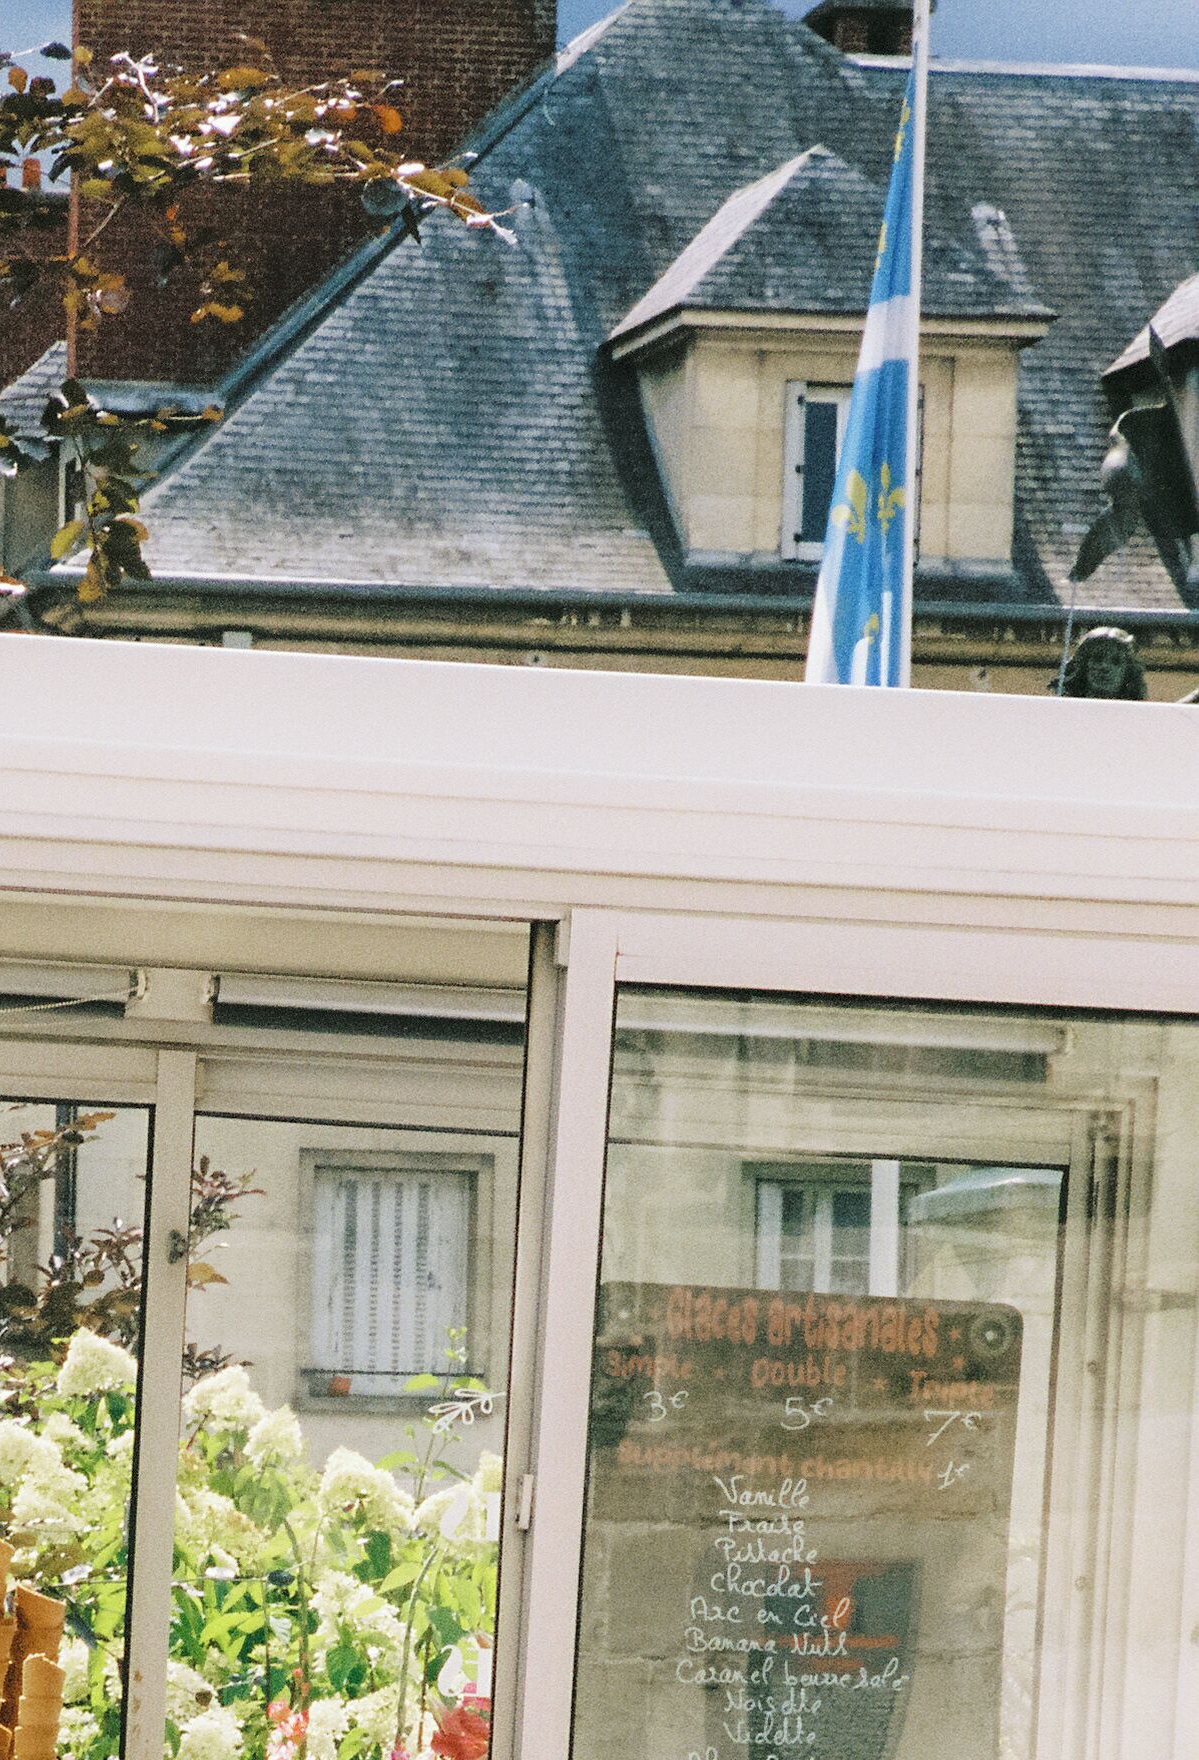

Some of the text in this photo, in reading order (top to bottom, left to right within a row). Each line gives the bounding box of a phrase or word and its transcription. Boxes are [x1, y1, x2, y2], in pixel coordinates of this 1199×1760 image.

[779, 1396, 834, 1430] 5€
[713, 1474, 810, 1509] Vanille
[719, 1510, 806, 1534] Fraise
[714, 1535, 818, 1564] Pistache
[689, 1596, 851, 1628] Arc en Ciel
[684, 1626, 777, 1654] Banana
[676, 1657, 774, 1685] Caramel
[784, 1660, 852, 1687] beurre
[724, 1687, 822, 1714] Noisette
[723, 1711, 816, 1746] Violette
